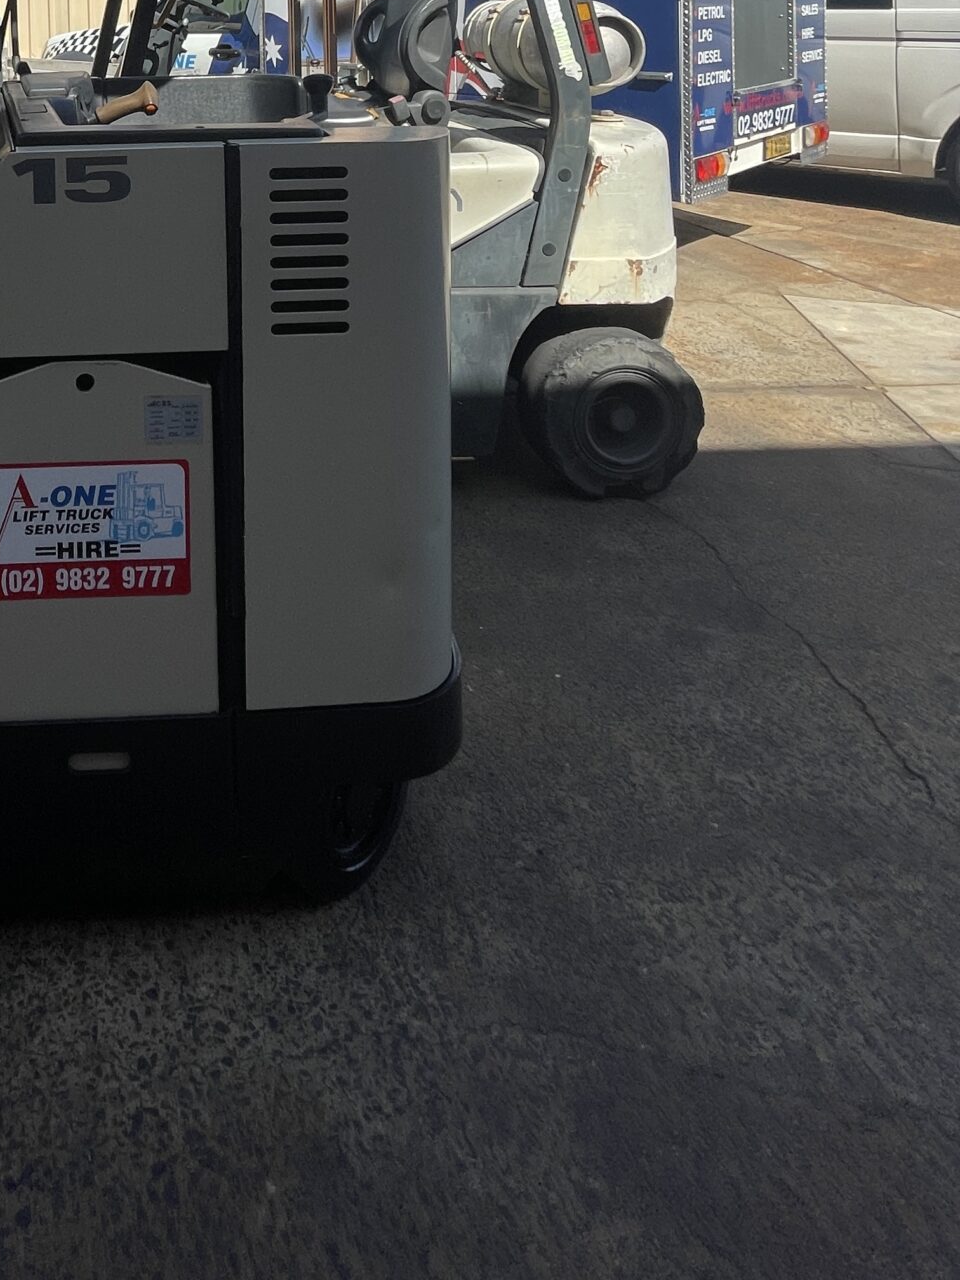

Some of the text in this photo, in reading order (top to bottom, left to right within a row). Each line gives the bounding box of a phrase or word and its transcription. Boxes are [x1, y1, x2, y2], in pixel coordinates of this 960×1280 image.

[697, 5, 725, 21] PETROL
[801, 3, 819, 17] SALES
[697, 28, 713, 43] LPG
[697, 49, 723, 65] DIESEL
[801, 48, 823, 64] SERVICE
[697, 69, 732, 87] ELECTRIC
[738, 115, 751, 136] 02
[752, 109, 774, 133] 9832
[774, 103, 795, 126] 9777
[12, 155, 132, 205] 15
[12, 508, 115, 523] LIFT TRUCK
[24, 522, 101, 536] SERVICES
[0, 565, 176, 597] (02) 9832 9777
